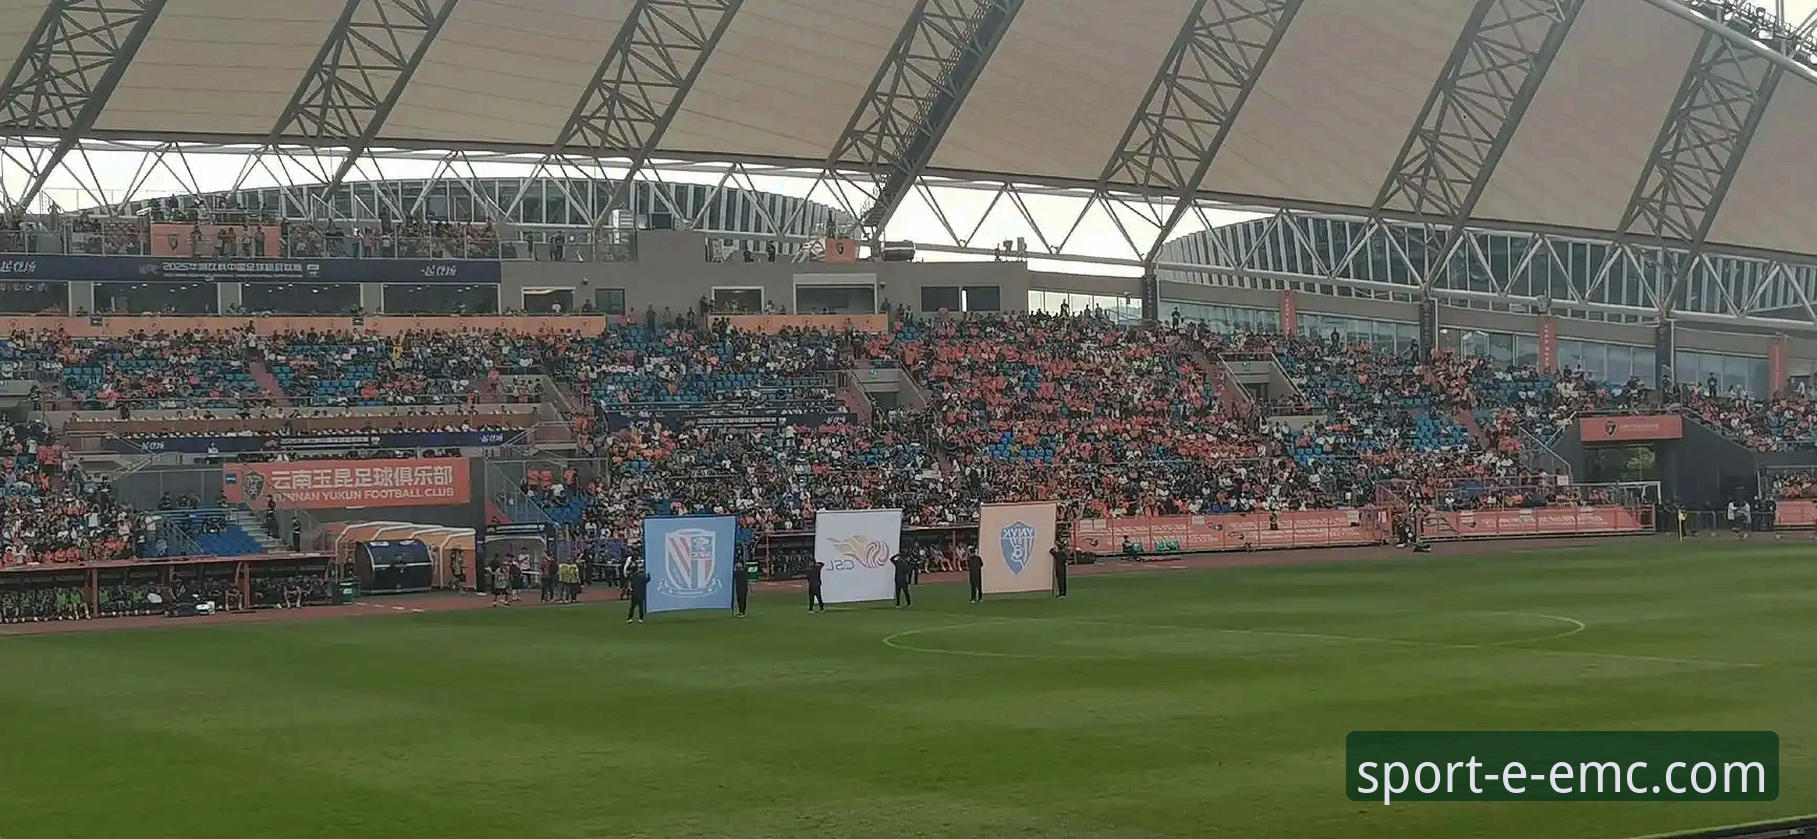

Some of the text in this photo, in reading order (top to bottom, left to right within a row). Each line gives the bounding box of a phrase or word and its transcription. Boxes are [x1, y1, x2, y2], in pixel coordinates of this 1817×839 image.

[271, 466, 453, 490] 云南玉昆足球俱乐部
[321, 489, 361, 501] YUKUN
[364, 488, 424, 499] FOOTBALL
[424, 487, 454, 497] CLUB
